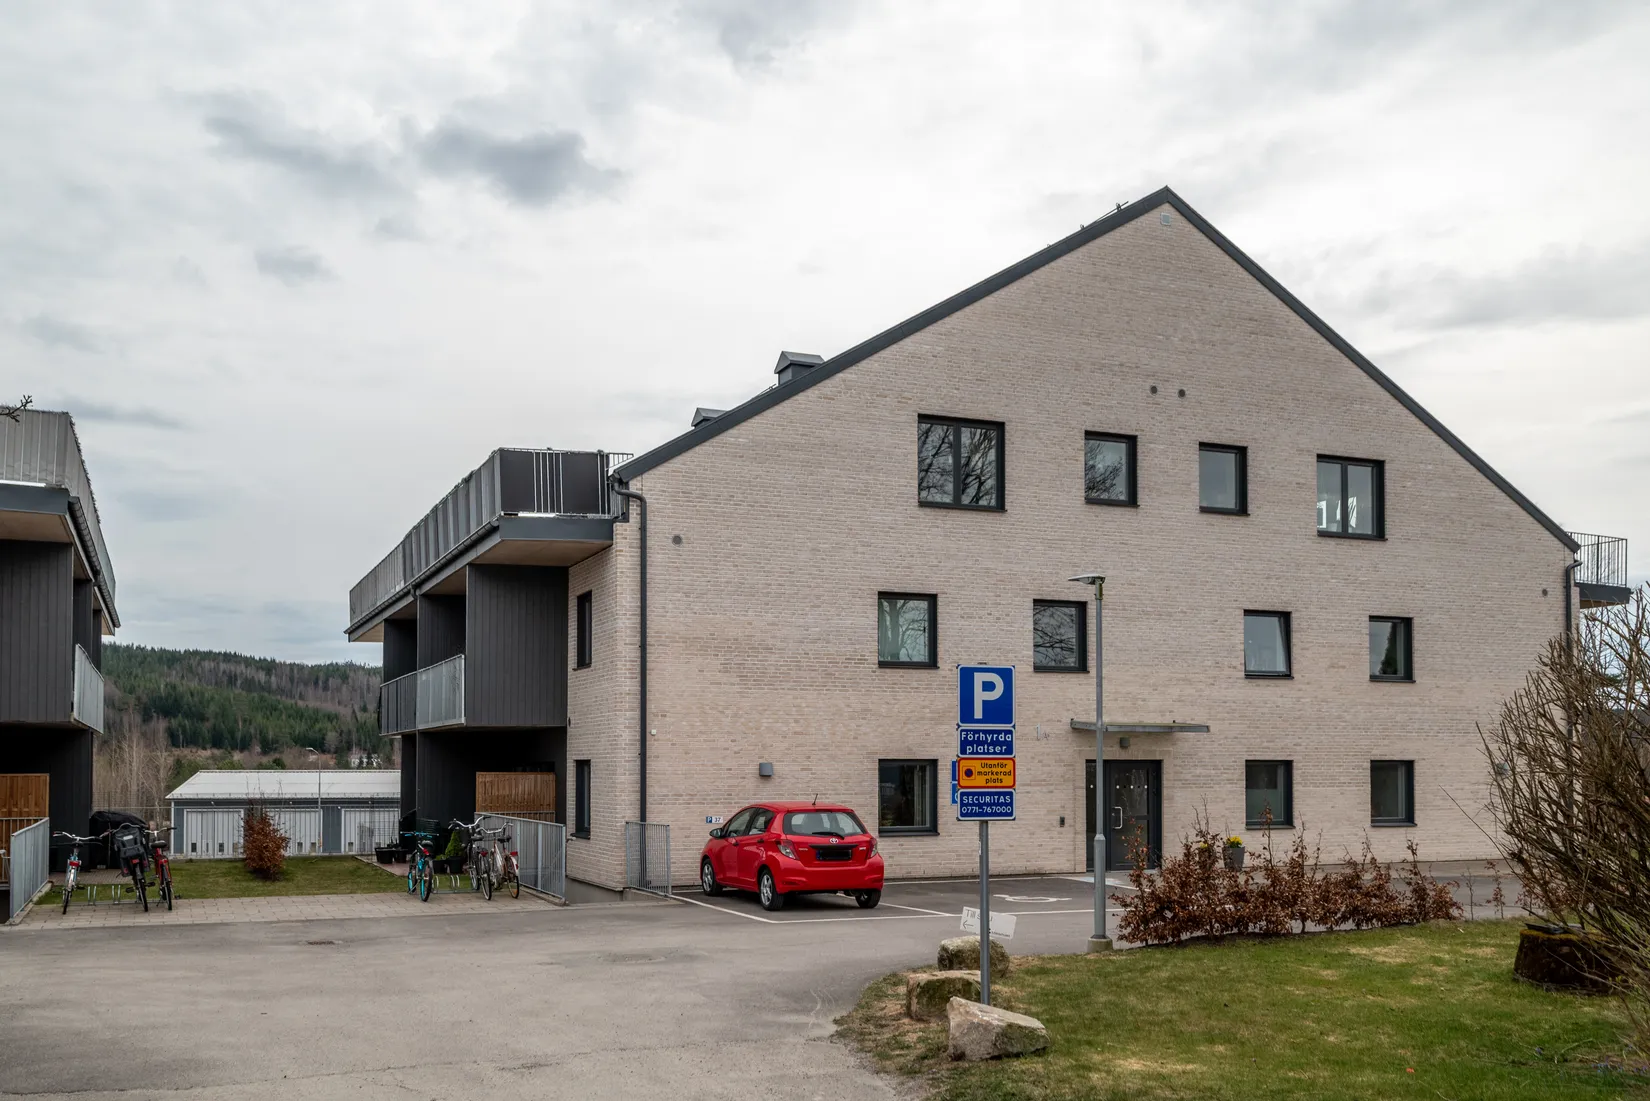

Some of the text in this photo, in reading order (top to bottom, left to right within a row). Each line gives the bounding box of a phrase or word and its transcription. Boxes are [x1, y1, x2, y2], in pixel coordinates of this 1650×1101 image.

[973, 671, 1004, 719] P
[961, 731, 1012, 743] Förhyrda
[966, 743, 1007, 755] platser
[980, 761, 1008, 769] Utanför
[976, 769, 1012, 777] markerad
[985, 777, 1004, 785] plats
[962, 795, 1011, 804] SECURITAS
[961, 805, 1012, 814] 0771-767000
